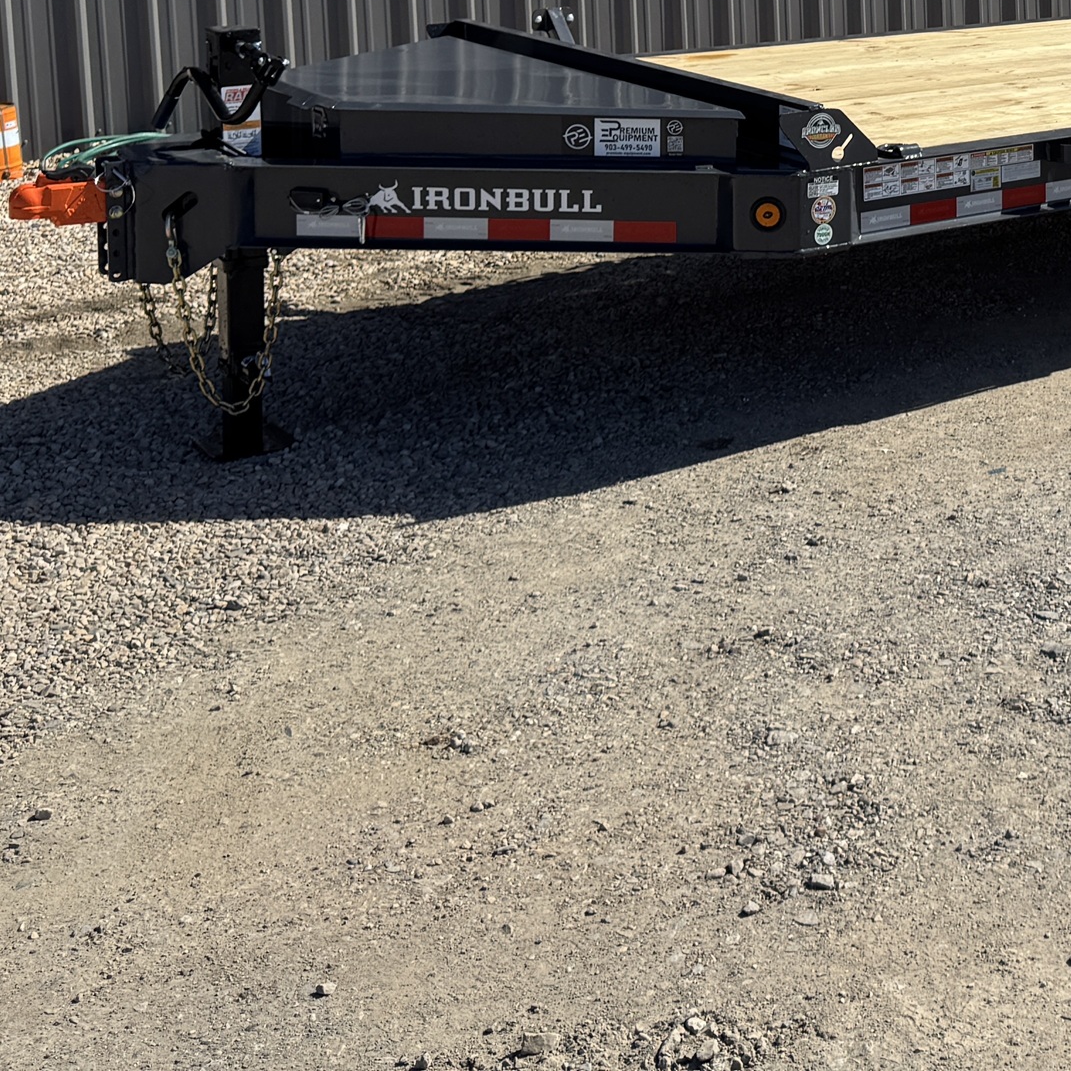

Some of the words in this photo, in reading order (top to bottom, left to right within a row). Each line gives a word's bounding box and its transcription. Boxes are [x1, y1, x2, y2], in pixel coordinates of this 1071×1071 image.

[604, 143, 653, 152] 903-499-5490
[814, 175, 833, 184] NOTICE
[411, 186, 602, 213] IRONBULL
